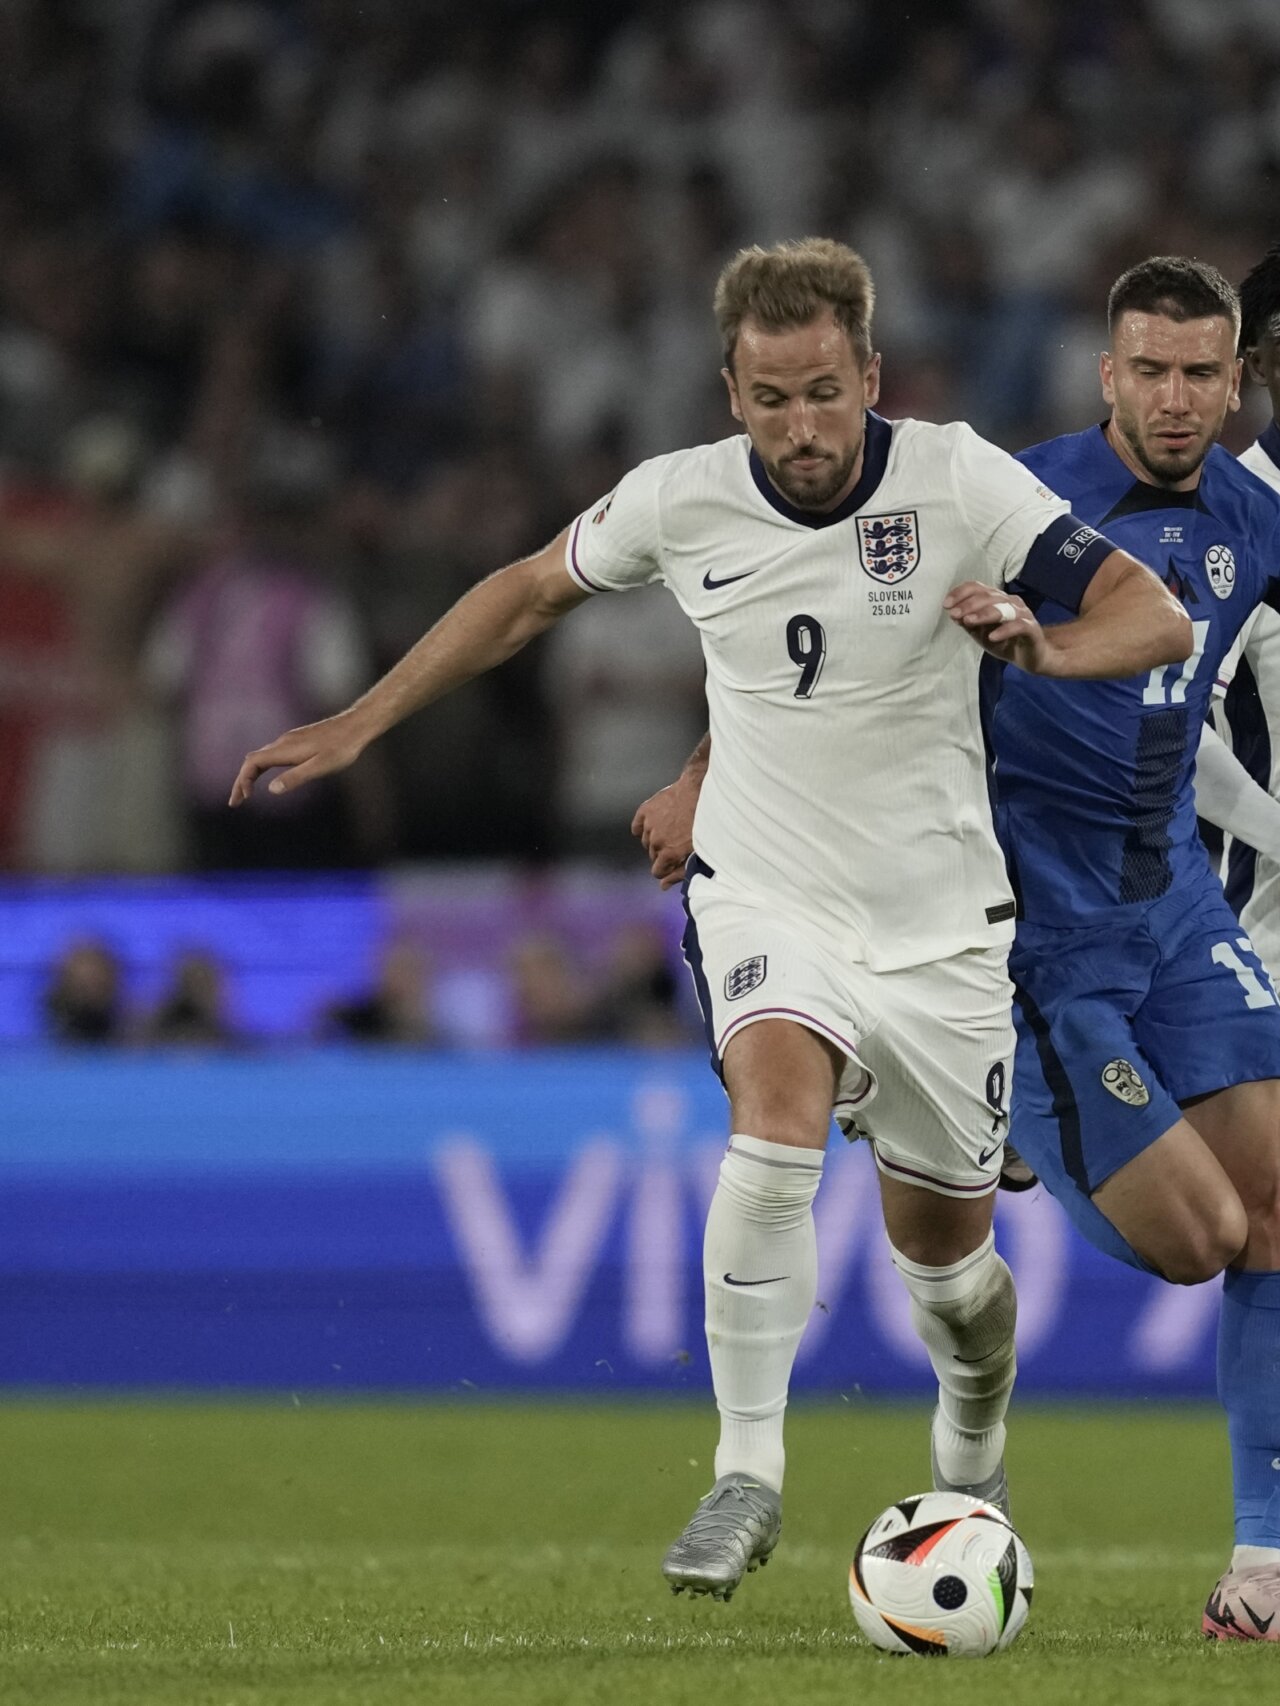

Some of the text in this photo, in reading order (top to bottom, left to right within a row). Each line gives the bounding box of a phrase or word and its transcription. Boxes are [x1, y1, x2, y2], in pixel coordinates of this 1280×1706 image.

[868, 590, 913, 602] SLOVENIA
[872, 604, 910, 615] 25.06.24
[786, 614, 826, 699] 9
[986, 1061, 1007, 1135] 9
